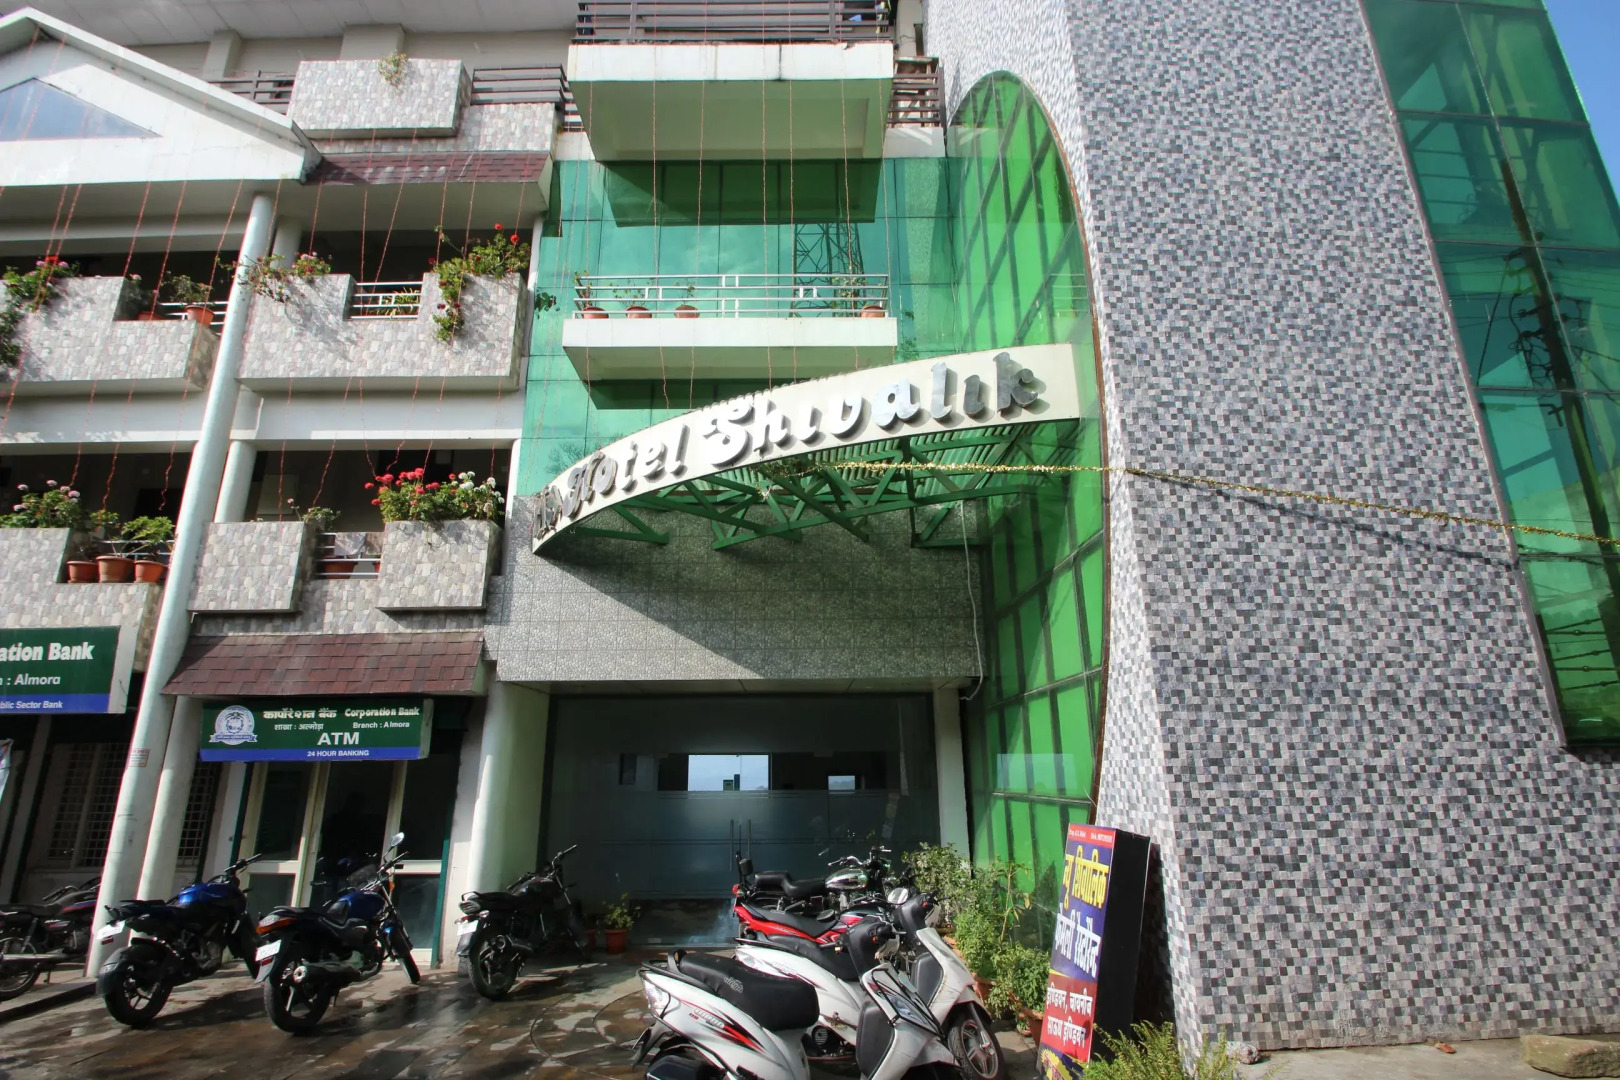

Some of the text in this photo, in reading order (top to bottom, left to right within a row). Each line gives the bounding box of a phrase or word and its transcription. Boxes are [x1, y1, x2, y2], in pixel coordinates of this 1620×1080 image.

[702, 351, 1042, 468] Shivalik
[48, 642, 95, 660] Bank
[14, 673, 60, 685] Almora
[16, 701, 41, 709] Sector
[42, 701, 63, 709] Bank
[344, 706, 420, 719] Corporation Bank
[352, 721, 378, 729] Branch
[317, 731, 360, 746] ATM
[338, 749, 370, 757] BANKING
